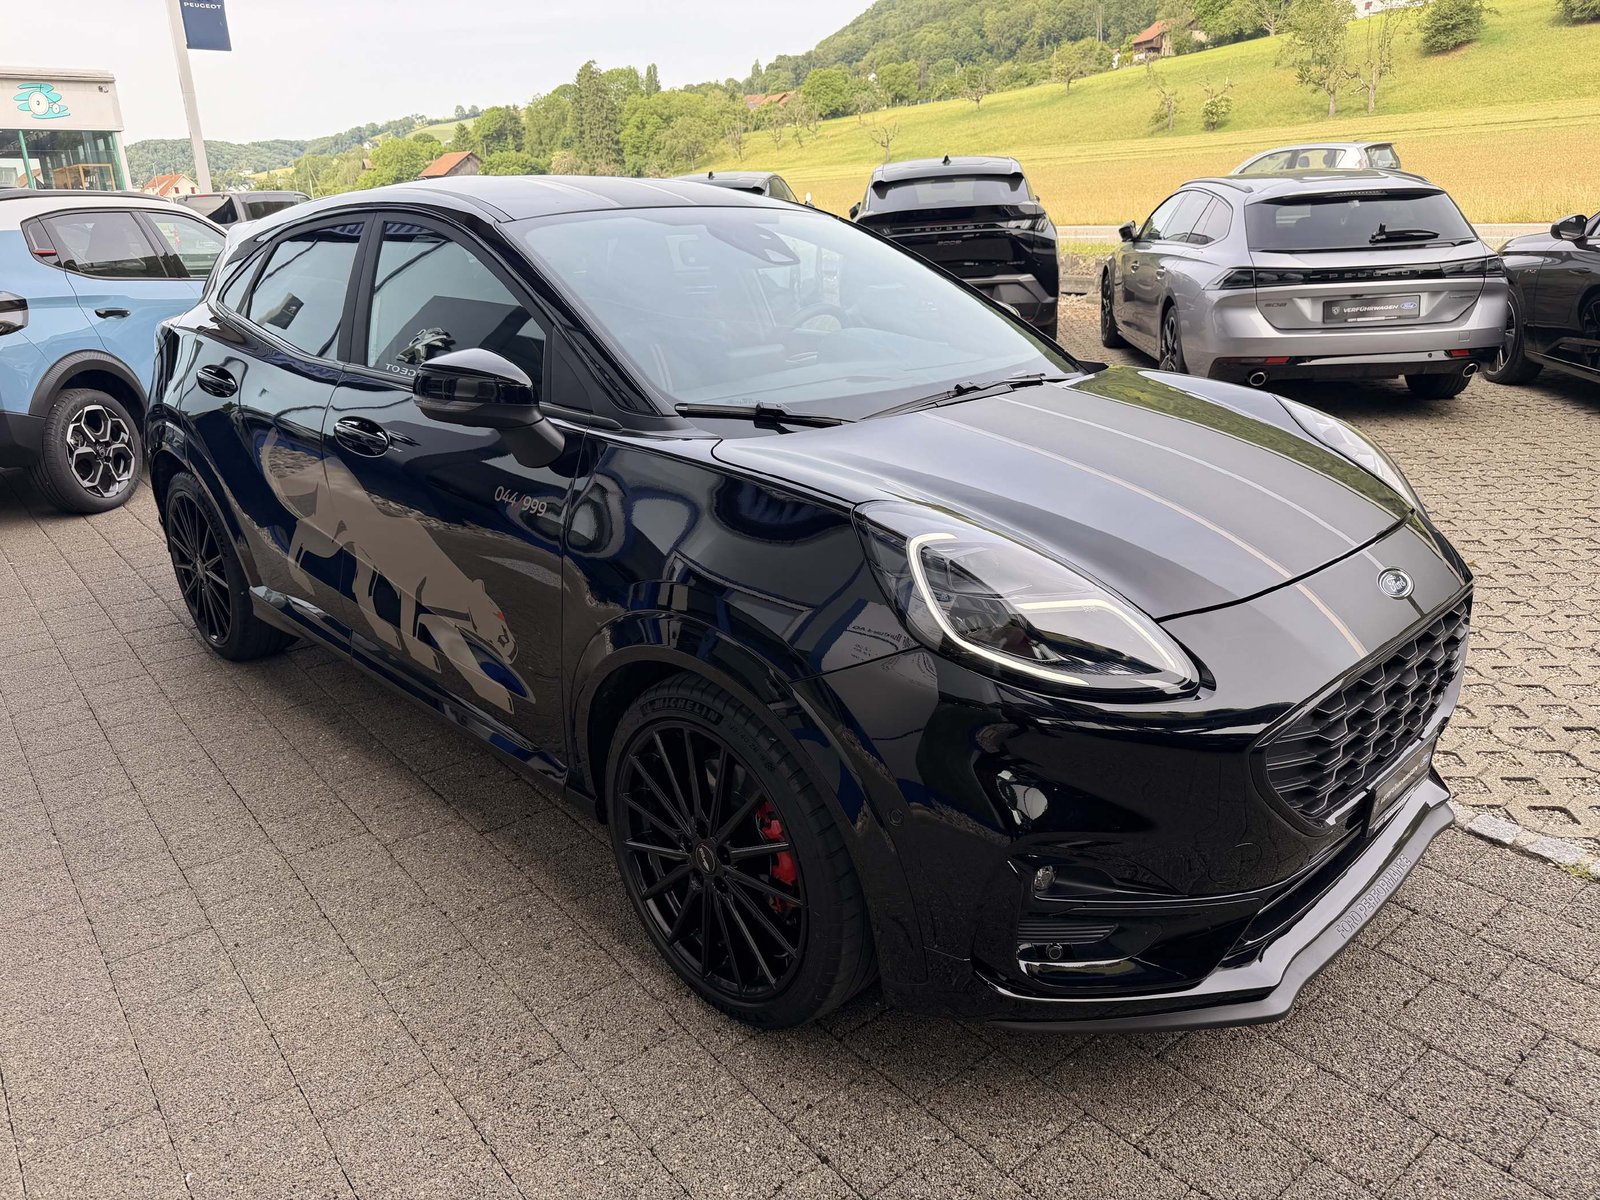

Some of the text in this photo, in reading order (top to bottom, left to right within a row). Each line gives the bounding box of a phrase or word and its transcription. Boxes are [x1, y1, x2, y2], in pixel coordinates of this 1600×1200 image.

[183, 1, 222, 10] PEUGEOT
[494, 485, 547, 517] 044/999
[655, 697, 719, 723] MICHELIN
[1334, 910, 1363, 940] FORD
[1356, 854, 1412, 918] PERFORMANCE
